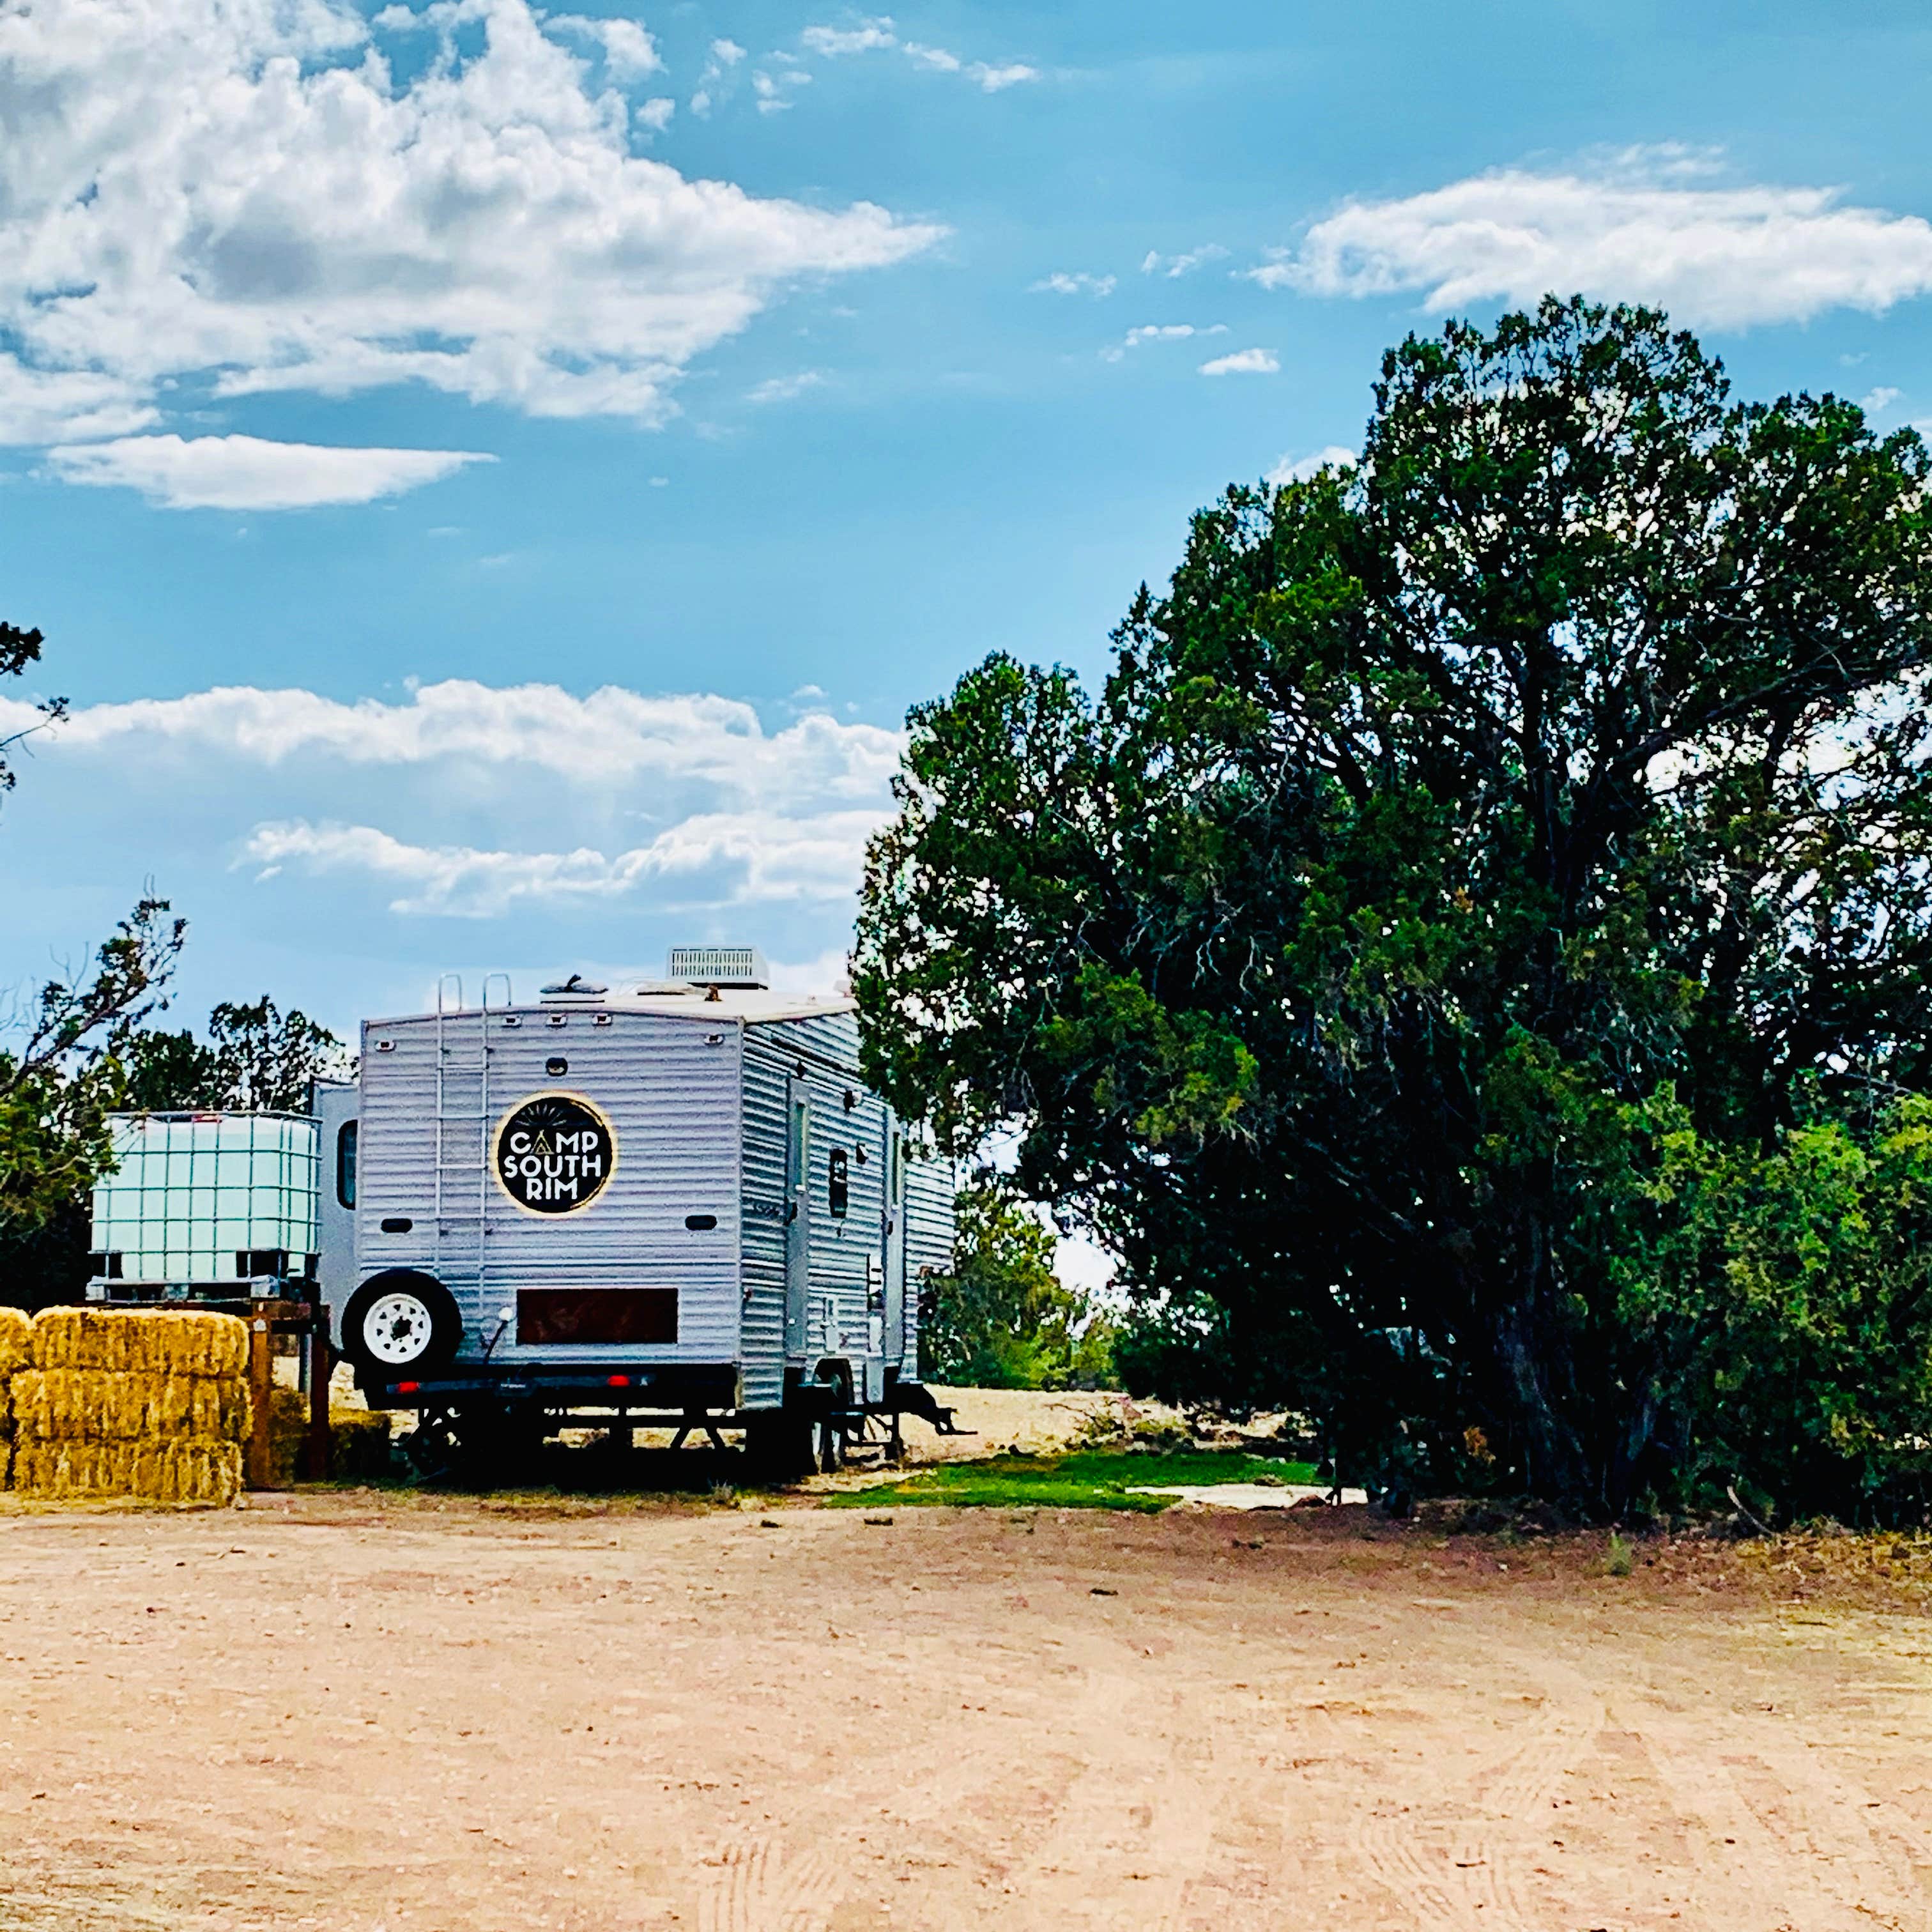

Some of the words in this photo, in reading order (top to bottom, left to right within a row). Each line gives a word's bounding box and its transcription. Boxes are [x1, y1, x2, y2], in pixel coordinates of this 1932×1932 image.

[510, 1130, 598, 1154] CAMP
[504, 1154, 601, 1178] SOUTH
[526, 1177, 578, 1200] RIM
